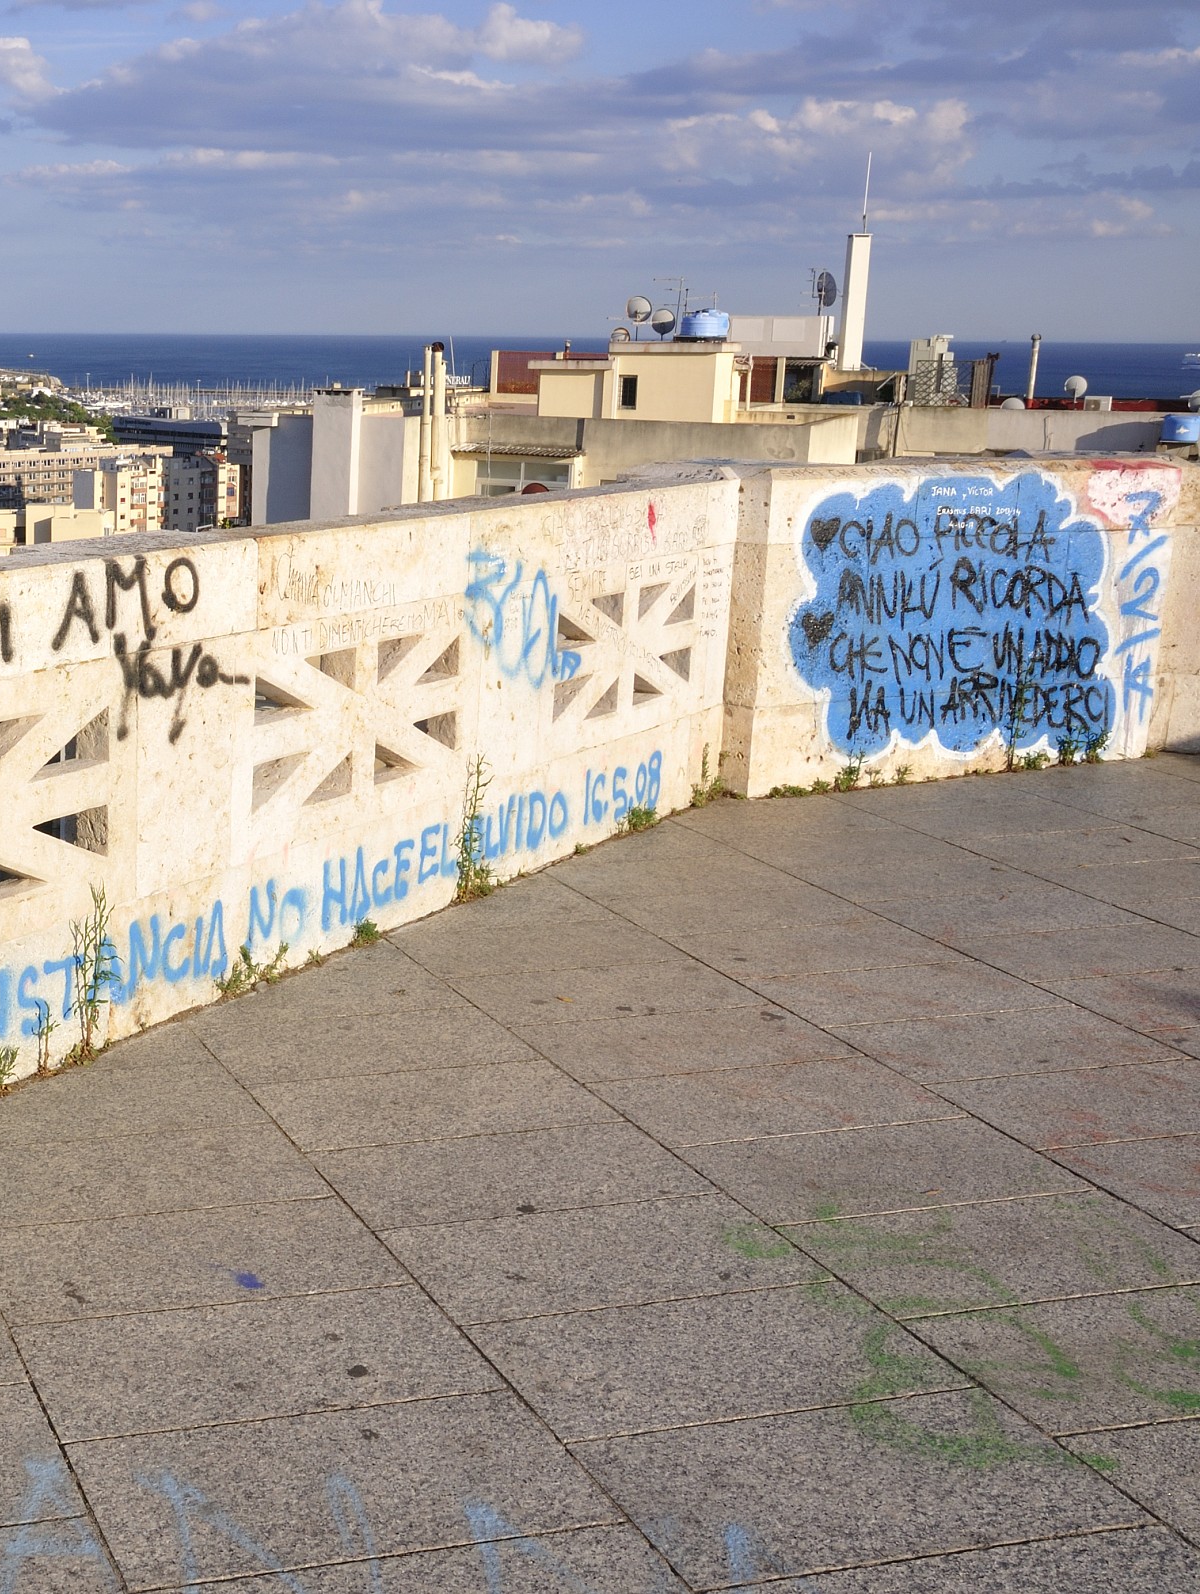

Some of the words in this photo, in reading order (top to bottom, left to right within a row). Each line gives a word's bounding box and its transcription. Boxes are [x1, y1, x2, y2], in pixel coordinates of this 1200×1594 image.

[931, 486, 957, 497] JANA
[840, 512, 919, 564] CIAO
[52, 555, 199, 651] AMO
[949, 556, 1088, 623] RICORDA
[830, 632, 888, 674] CHE
[1028, 628, 1100, 679] ADDIO
[847, 680, 890, 739] MA
[900, 688, 934, 728] UN
[246, 878, 307, 950] NO
[322, 839, 414, 932] HACE
[418, 823, 458, 884] EL
